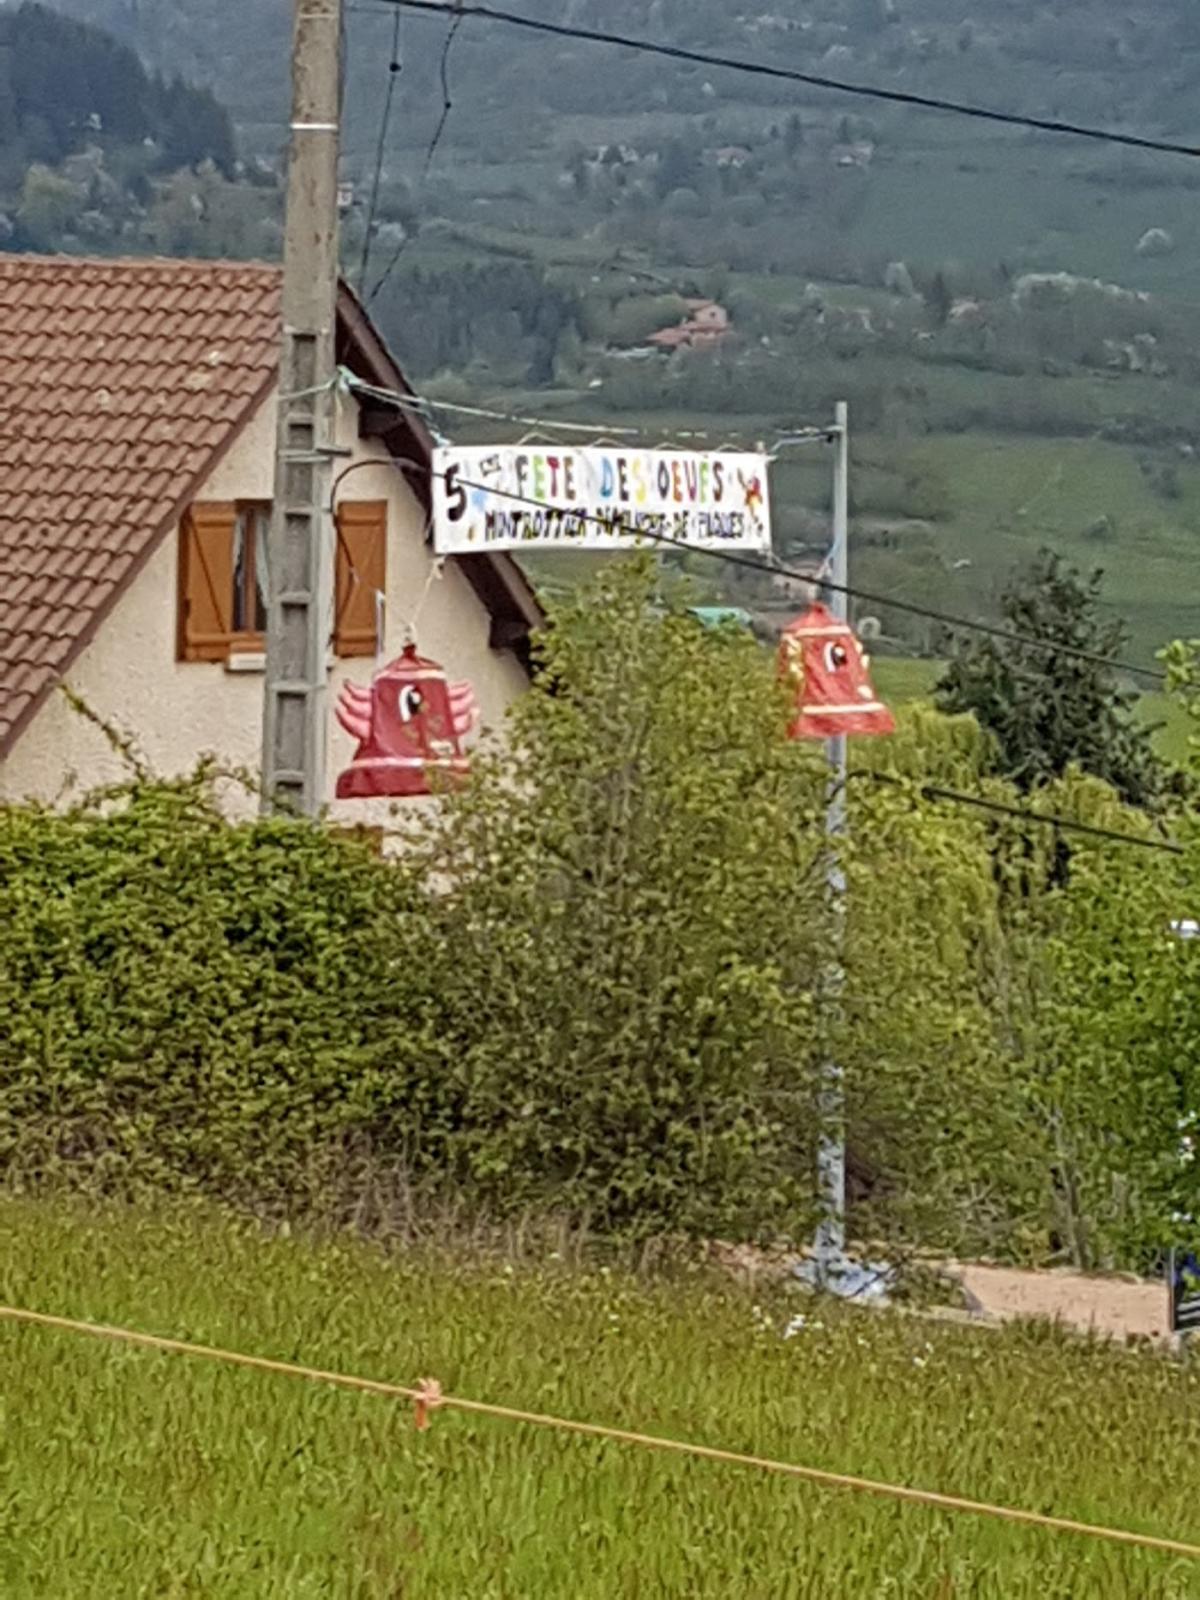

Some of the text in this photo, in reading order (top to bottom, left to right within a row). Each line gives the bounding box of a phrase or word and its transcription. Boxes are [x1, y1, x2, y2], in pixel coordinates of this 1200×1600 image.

[444, 463, 467, 521] 5
[600, 456, 647, 502] DES
[657, 459, 723, 503] OEUFS
